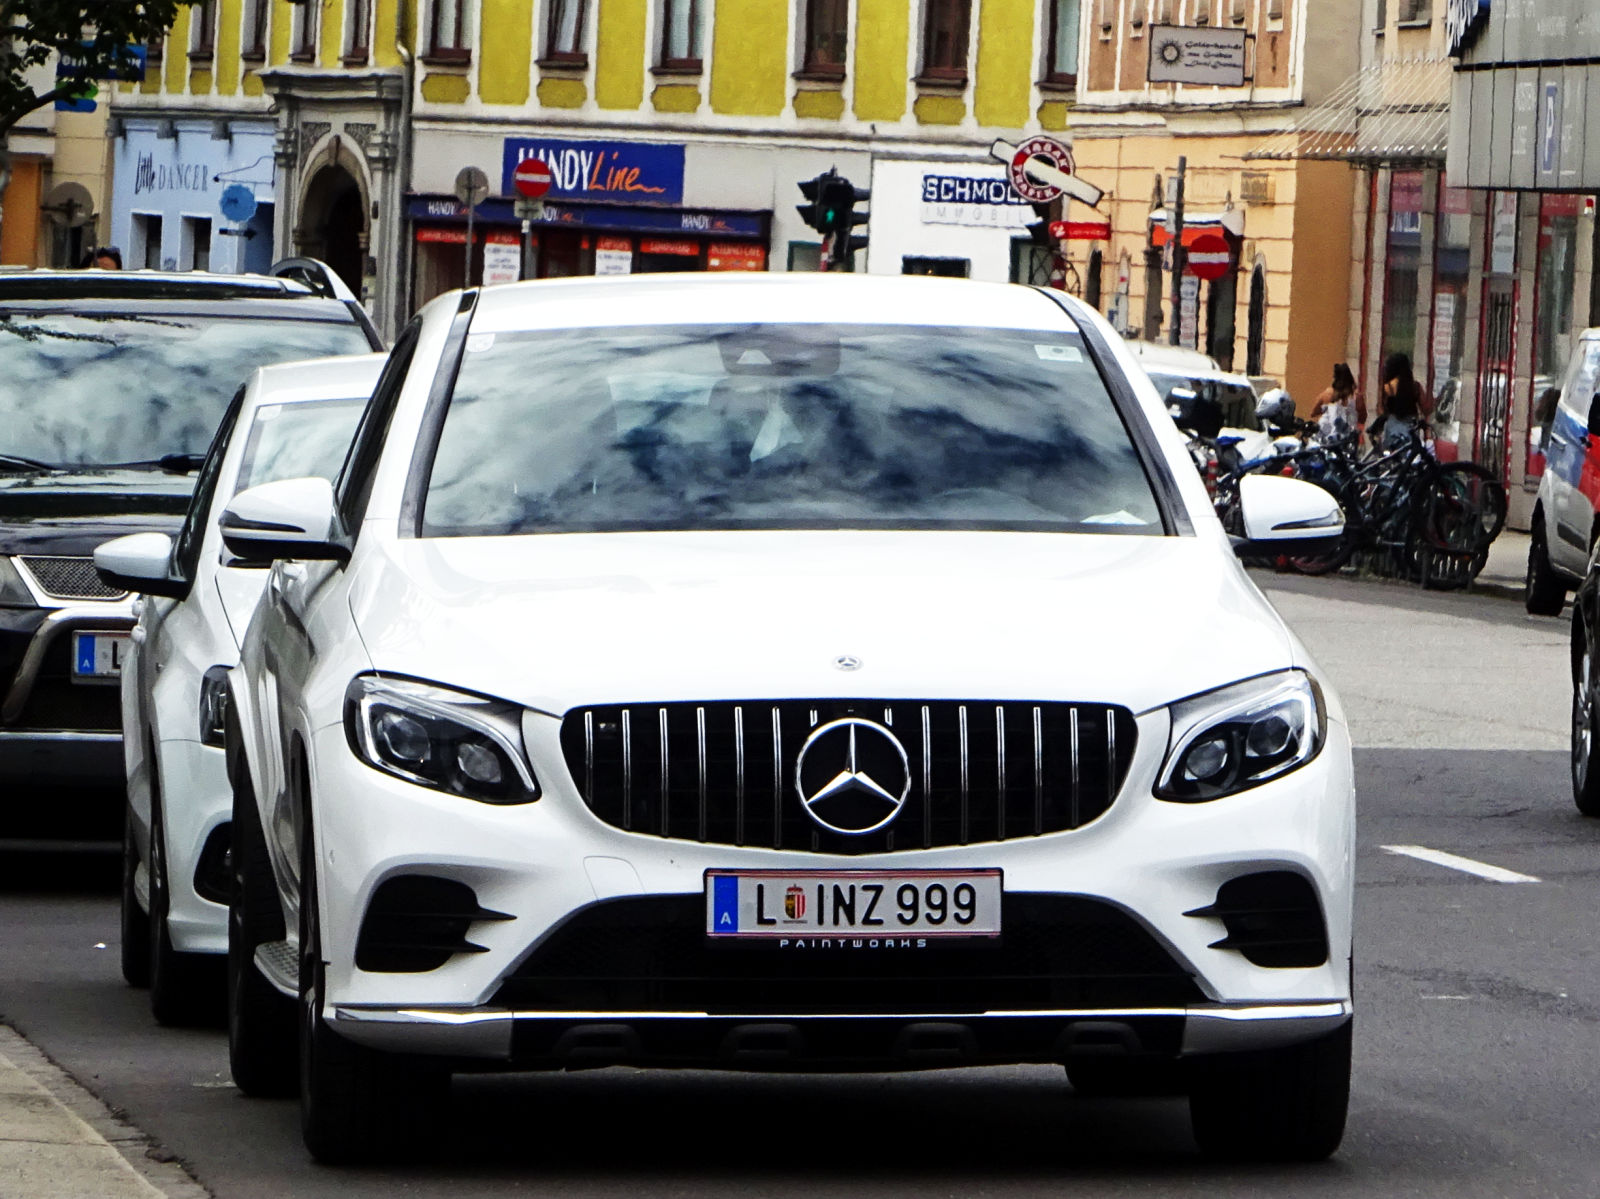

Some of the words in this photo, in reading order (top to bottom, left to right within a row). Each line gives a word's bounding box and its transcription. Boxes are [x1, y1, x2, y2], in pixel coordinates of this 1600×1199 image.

[158, 163, 209, 192] DANCER
[518, 147, 593, 191] NDY
[588, 151, 666, 193] Line
[925, 177, 1028, 203] SCHMOL
[428, 200, 456, 216] HANDY
[681, 213, 710, 230] HANDY
[757, 883, 777, 926] L
[817, 883, 884, 926] INZ
[896, 883, 977, 926] 999
[719, 911, 732, 925] A
[780, 938, 928, 949] PAINTWORKS
